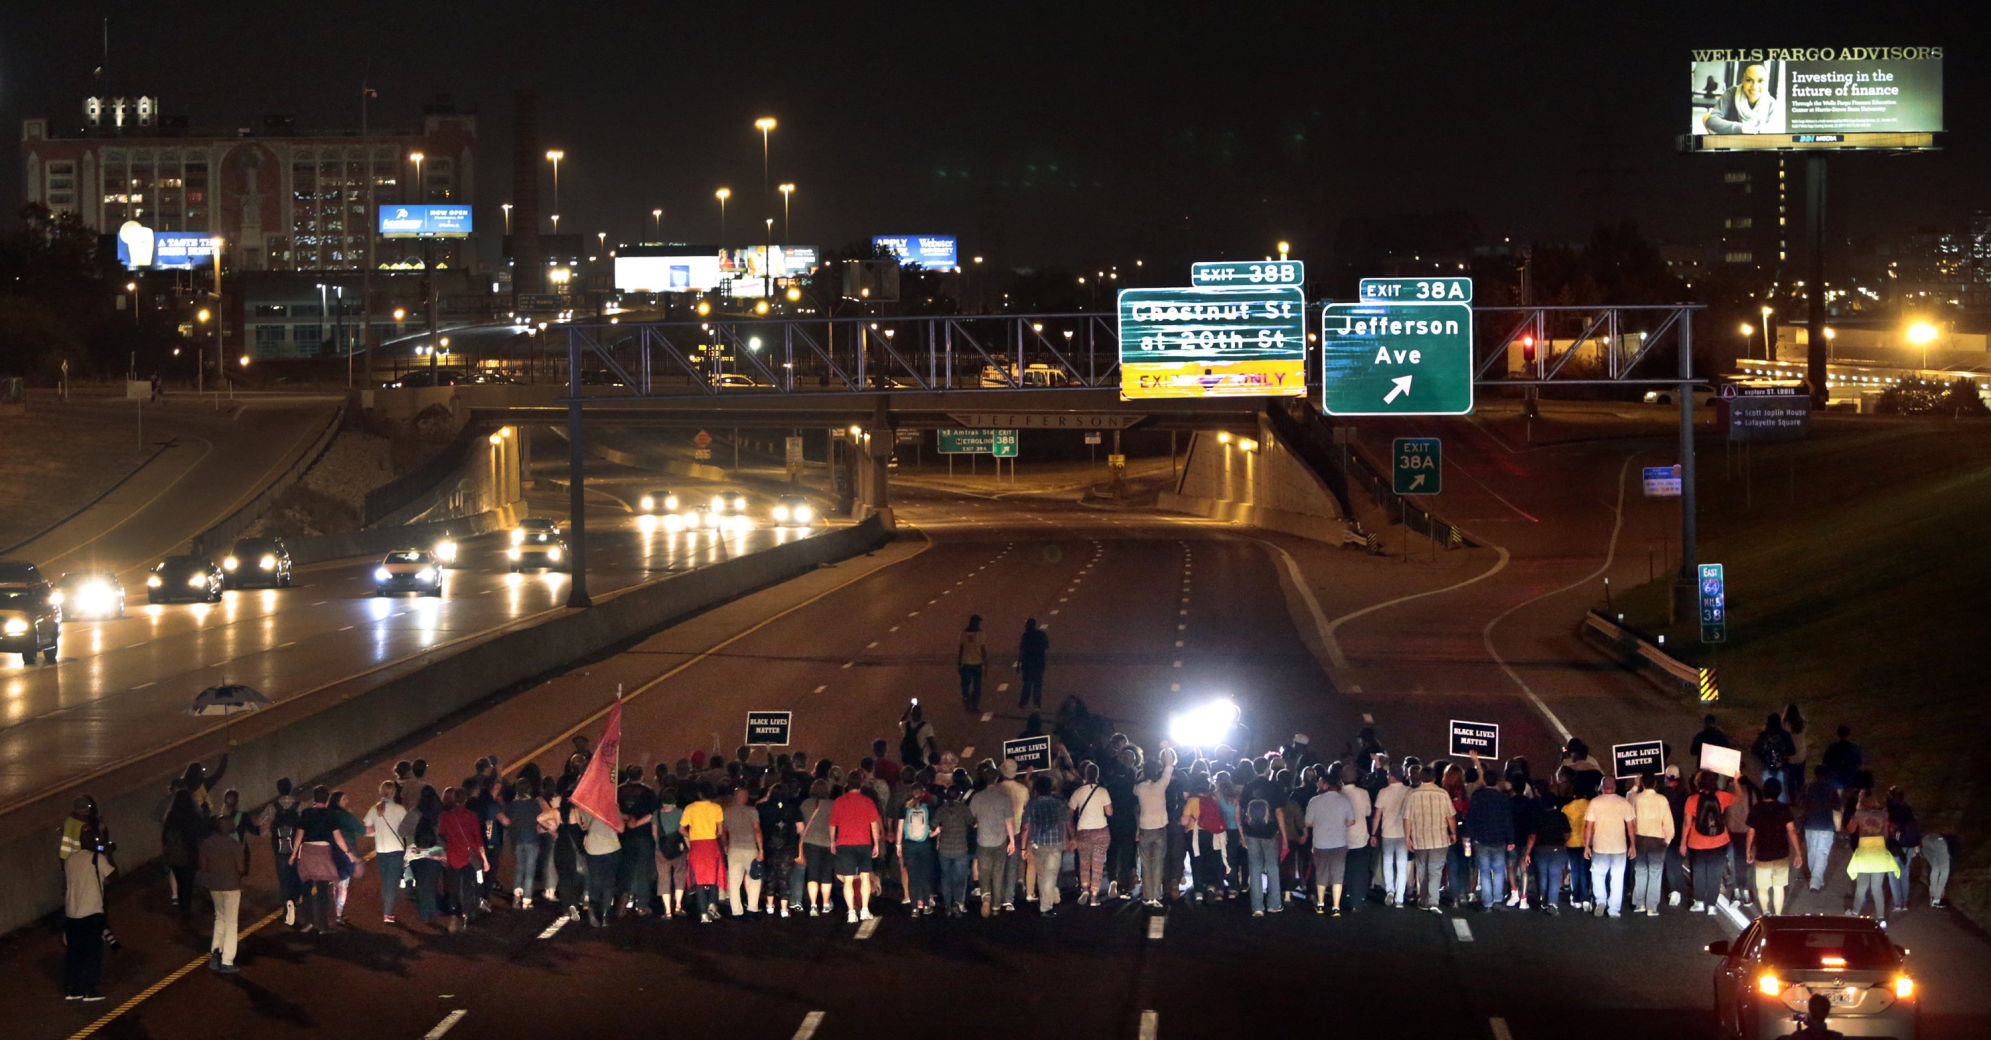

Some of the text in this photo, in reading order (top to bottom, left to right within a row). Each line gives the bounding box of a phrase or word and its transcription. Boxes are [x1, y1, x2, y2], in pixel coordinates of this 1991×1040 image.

[1692, 46, 1944, 62] WELLS FARGO ADVISORS
[1792, 69, 1894, 83] Investing in the
[1792, 83, 1899, 96] future of finance
[1200, 265, 1295, 283] EXIT 38B
[1367, 282, 1465, 299] EXIT 38A
[1132, 301, 1292, 322] Chestnut St
[1337, 317, 1459, 336] Jefferson
[1140, 330, 1284, 351] at 20th St
[1374, 346, 1421, 365] Ave
[976, 415, 1118, 426] JEFFERSON
[997, 436, 1015, 444] 38B
[1404, 442, 1430, 453] EXIT
[1400, 455, 1435, 469] 38A
[1703, 567, 1717, 577] EAST
[1704, 584, 1717, 593] 64
[1704, 609, 1721, 621] 38
[1454, 727, 1495, 738] BLACK LIVES
[1460, 737, 1487, 746] MATTER
[1007, 743, 1047, 754] BLACK LIVES
[1617, 748, 1659, 759] BLACK LIVES
[1015, 752, 1040, 762] MATTER
[1625, 757, 1652, 766] MATTER
